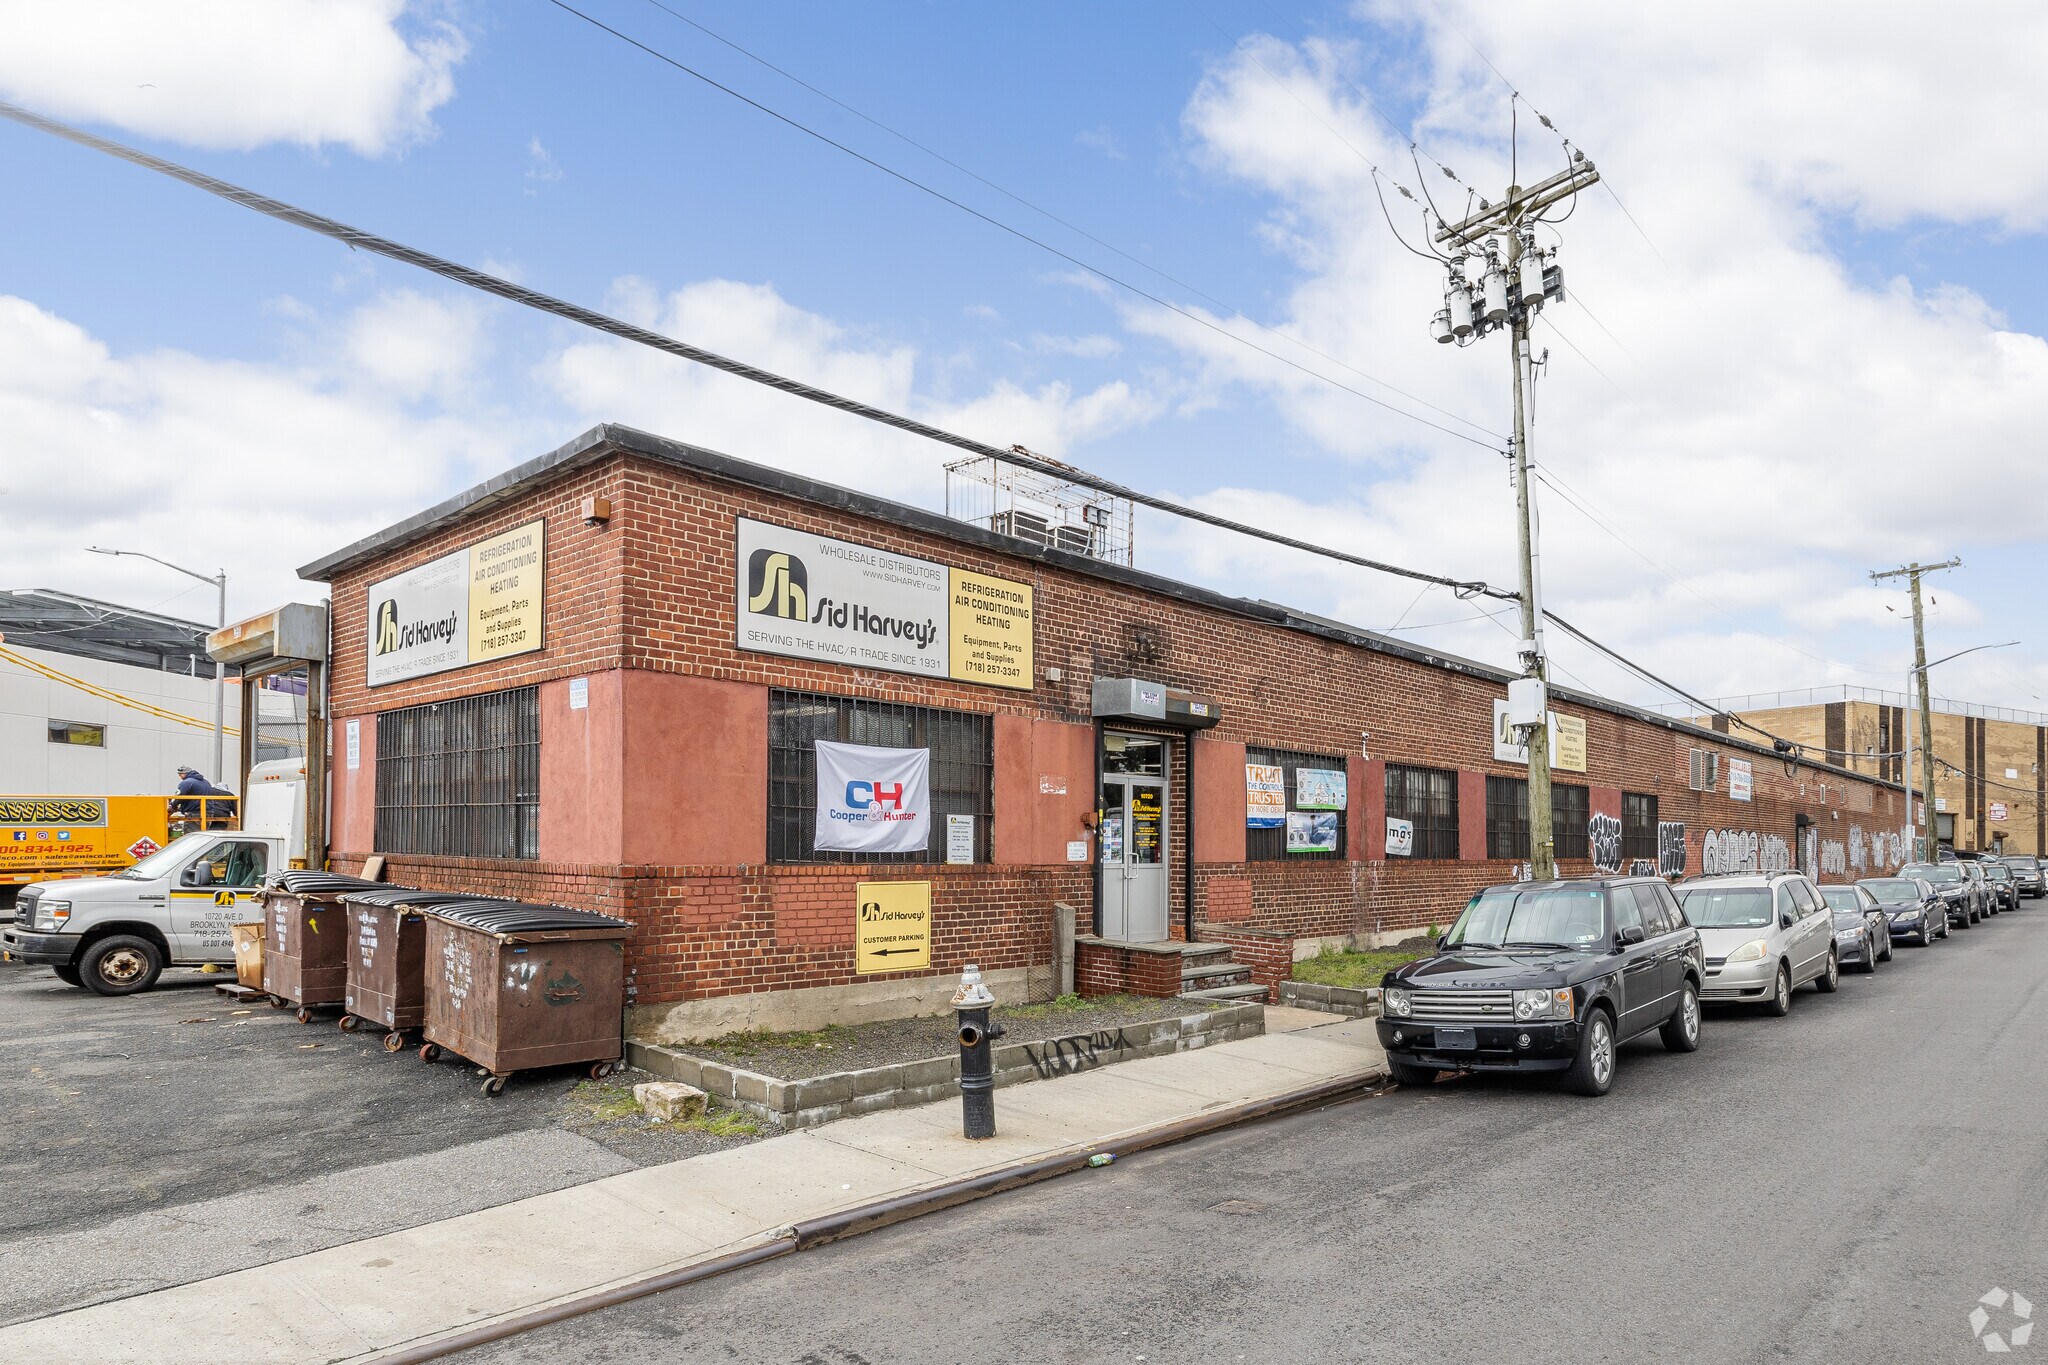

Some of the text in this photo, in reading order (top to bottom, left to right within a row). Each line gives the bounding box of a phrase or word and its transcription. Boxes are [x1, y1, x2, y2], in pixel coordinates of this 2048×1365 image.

[480, 534, 532, 563] REFRIGERATION
[474, 551, 537, 582] AIR CONDITIONING
[819, 543, 941, 581] WHOLESALE DISTRIBUTORS
[490, 575, 518, 595] HEATING
[862, 569, 941, 593] WWW.SIDHARVEY.COM
[961, 581, 1024, 604] REFRIGERATION
[480, 598, 529, 620] Equipment, Parts
[955, 595, 1029, 619] AIR CONDITIONING
[399, 609, 457, 650] Sid Harvey's
[486, 616, 521, 634] and Supplies
[811, 597, 937, 650] Sid Harvey's
[976, 614, 1011, 630] HEATING
[481, 630, 527, 652] (718) 257-3347
[747, 630, 941, 669] SERVING THE HVAC/R TRADE SINCE 1931
[963, 634, 1022, 653] Equipment, Parts
[447, 649, 459, 661] 1931
[972, 651, 1015, 665] and Supplies
[965, 660, 1020, 678] (718) 257-3347
[1247, 765, 1281, 783] TRUST
[1258, 783, 1283, 791] CONTROLS
[1248, 791, 1284, 805] TRUSTED
[830, 808, 868, 823] Cooper
[884, 811, 916, 822] Hunter
[205, 912, 222, 920] 10720
[238, 912, 243, 920] D
[881, 910, 925, 921] Sid Harvey's
[190, 921, 227, 929] BROOKLYN,
[863, 933, 925, 944] CUSTOMER PARKING
